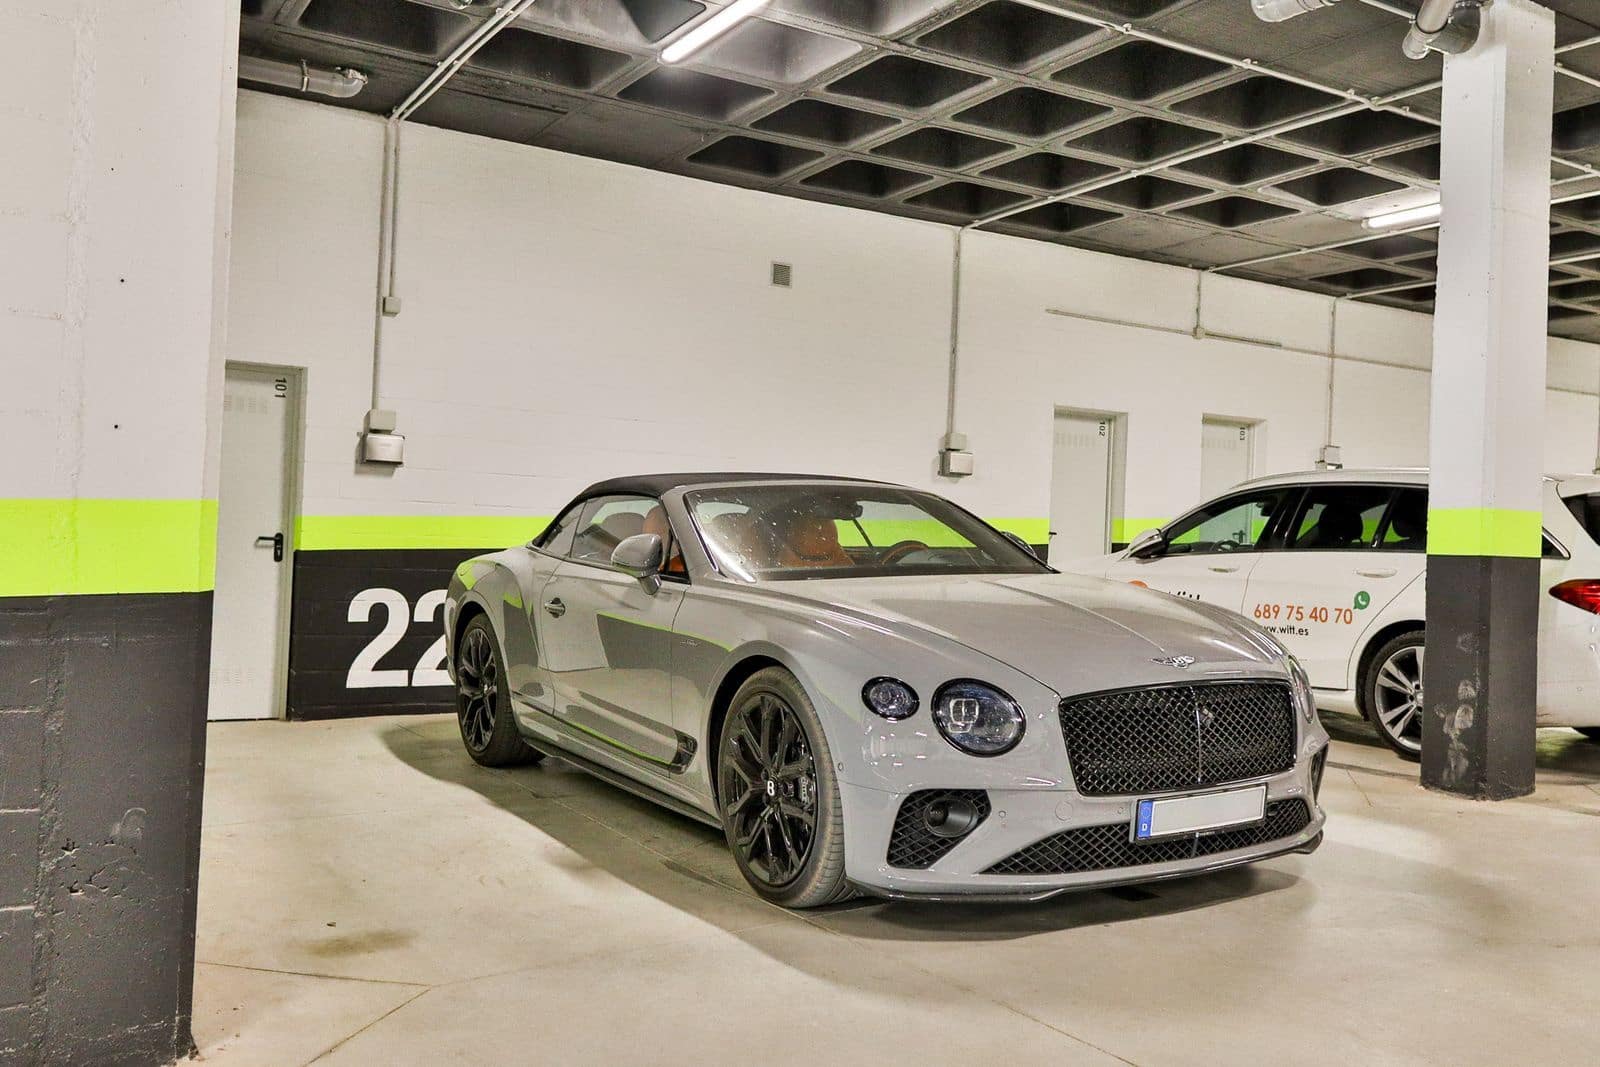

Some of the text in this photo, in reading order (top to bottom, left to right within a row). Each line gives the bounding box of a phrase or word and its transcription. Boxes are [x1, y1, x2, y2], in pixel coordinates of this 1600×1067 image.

[274, 377, 287, 398] 101
[1254, 603, 1353, 625] 689 75 40 70
[346, 588, 457, 689] 22
[1142, 823, 1148, 831] D
